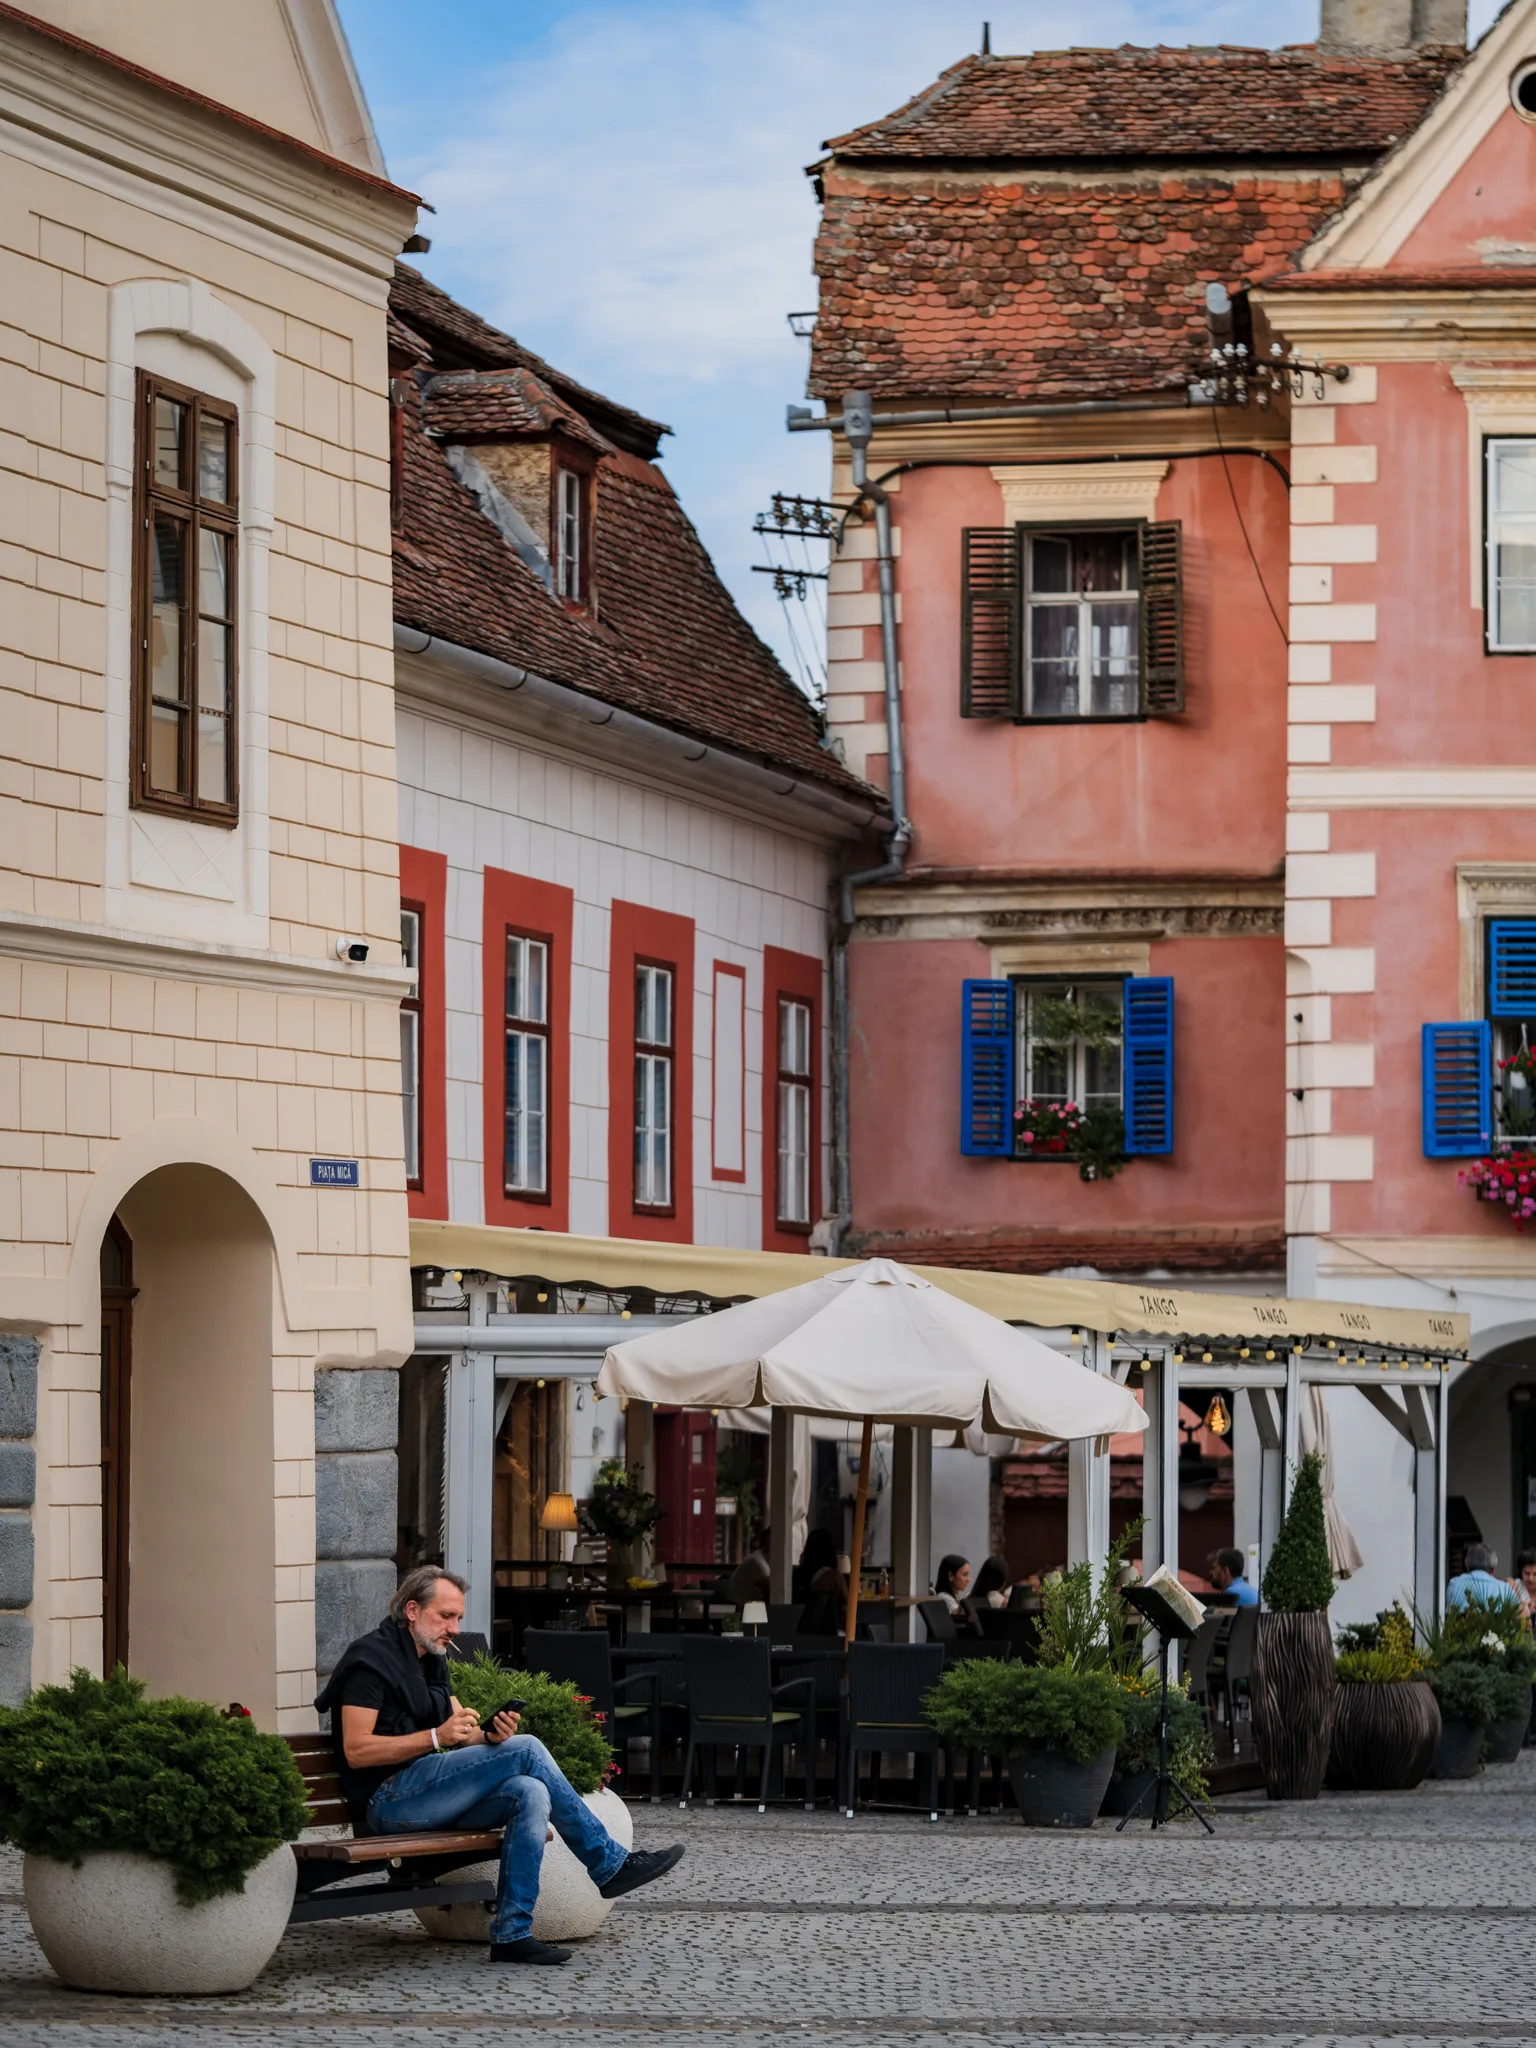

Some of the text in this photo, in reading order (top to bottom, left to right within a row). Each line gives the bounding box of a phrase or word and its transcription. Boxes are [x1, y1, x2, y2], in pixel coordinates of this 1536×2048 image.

[1139, 1295, 1178, 1316] TANGO
[1253, 1306, 1288, 1325] TANGO
[1340, 1312, 1371, 1331] TANGO
[1428, 1319, 1454, 1337] TANGO
